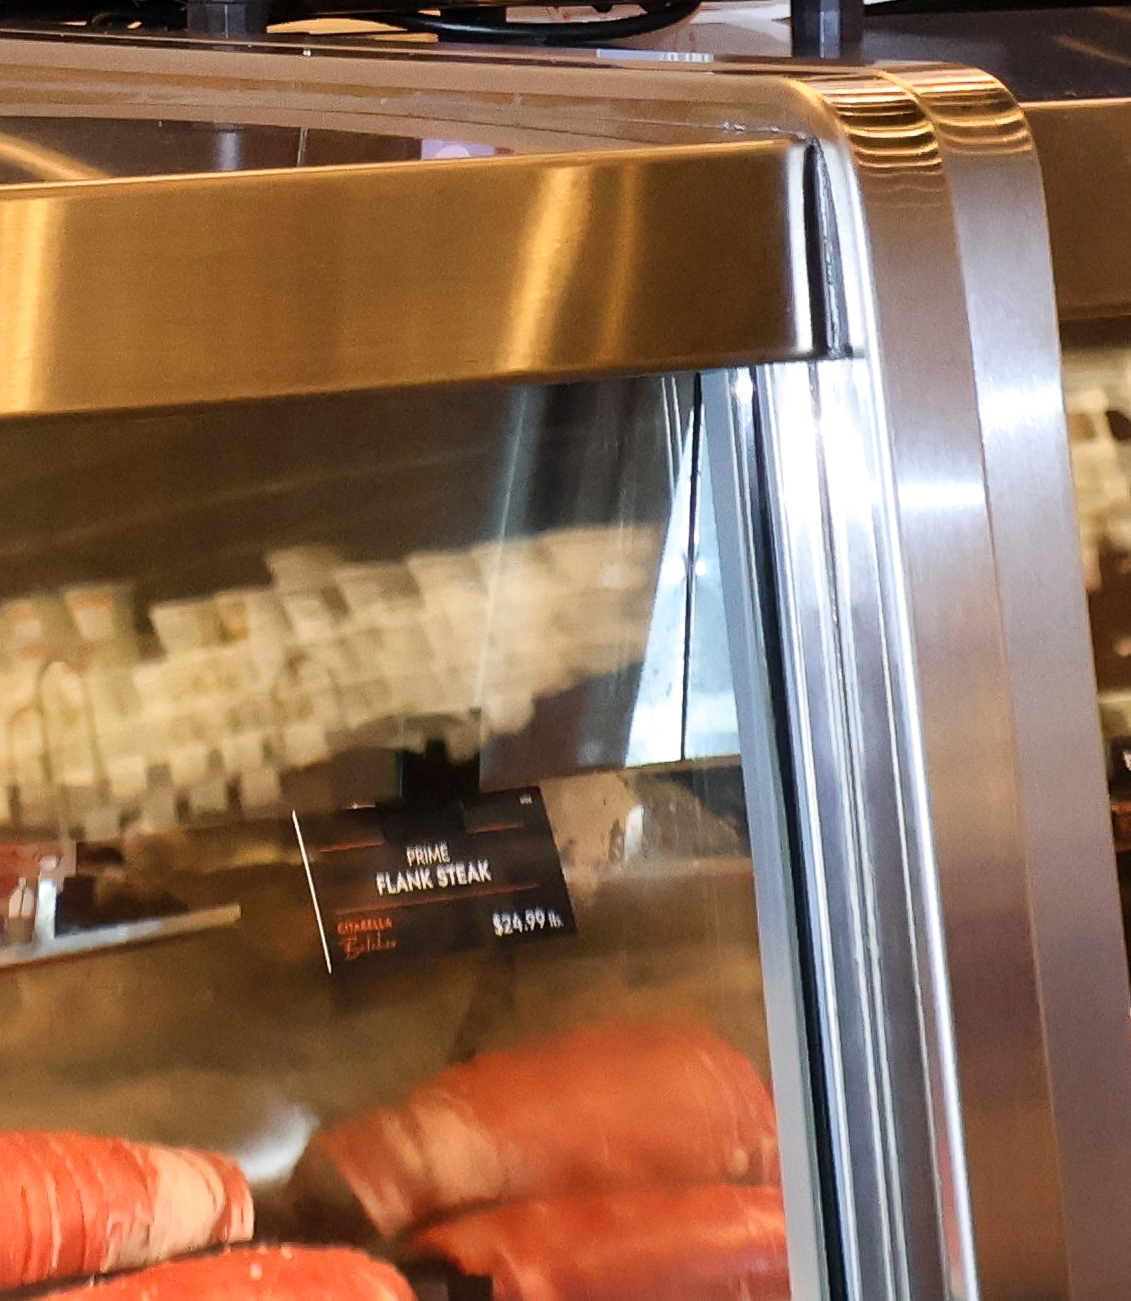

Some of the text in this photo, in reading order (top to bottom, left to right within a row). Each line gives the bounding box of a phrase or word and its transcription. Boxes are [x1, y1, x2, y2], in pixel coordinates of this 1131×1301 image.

[406, 842, 451, 867] PRIME
[375, 859, 492, 896] FLANK STEAK
[492, 907, 546, 937] $24.99
